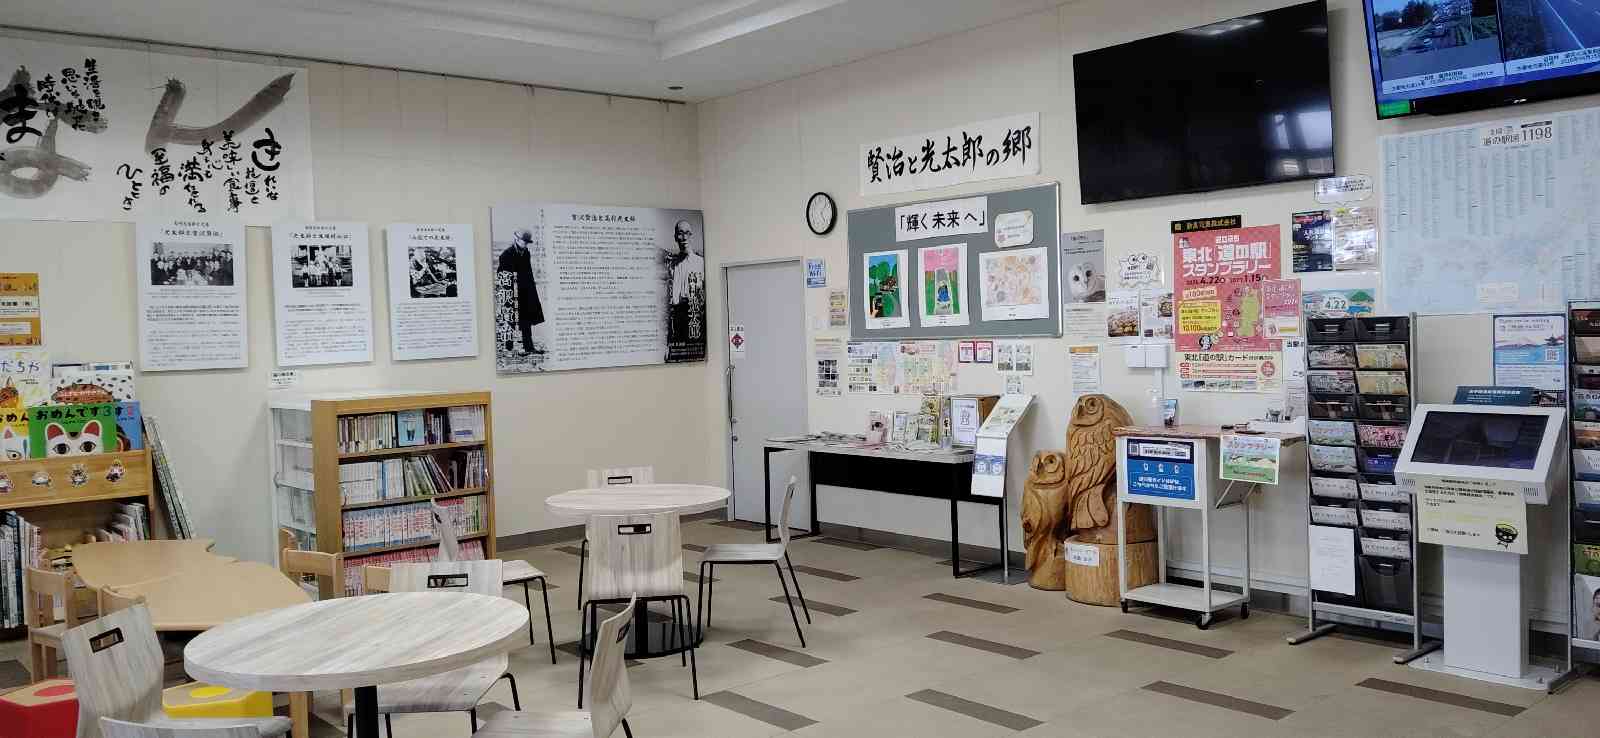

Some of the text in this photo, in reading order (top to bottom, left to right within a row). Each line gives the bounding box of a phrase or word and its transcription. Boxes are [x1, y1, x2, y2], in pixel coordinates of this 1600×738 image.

[1522, 126, 1552, 141] 1198
[866, 125, 1032, 184] 賢治と光太郎の郷
[899, 209, 987, 232] 「輝く未来へ」
[1183, 259, 1272, 277] スタンプラリー
[0, 413, 30, 426] めん
